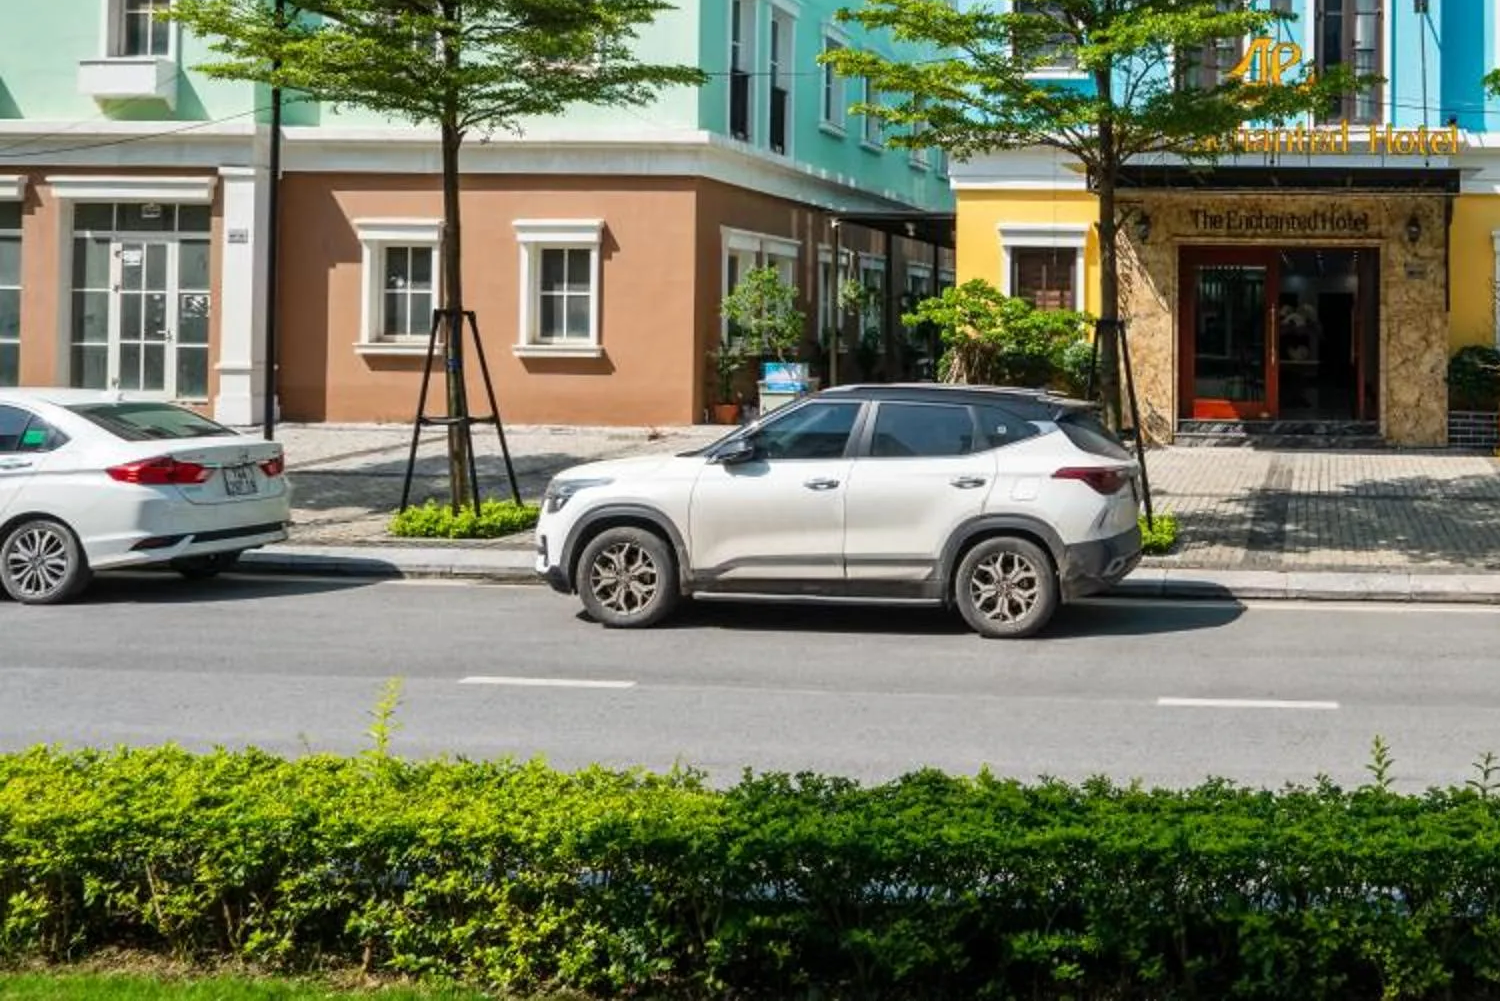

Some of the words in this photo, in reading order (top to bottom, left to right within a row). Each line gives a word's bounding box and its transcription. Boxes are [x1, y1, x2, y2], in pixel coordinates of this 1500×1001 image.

[1369, 123, 1459, 155] Hotel
[1189, 208, 1222, 230] The
[1226, 209, 1318, 231] Enchanted
[1320, 209, 1369, 231] Hotel
